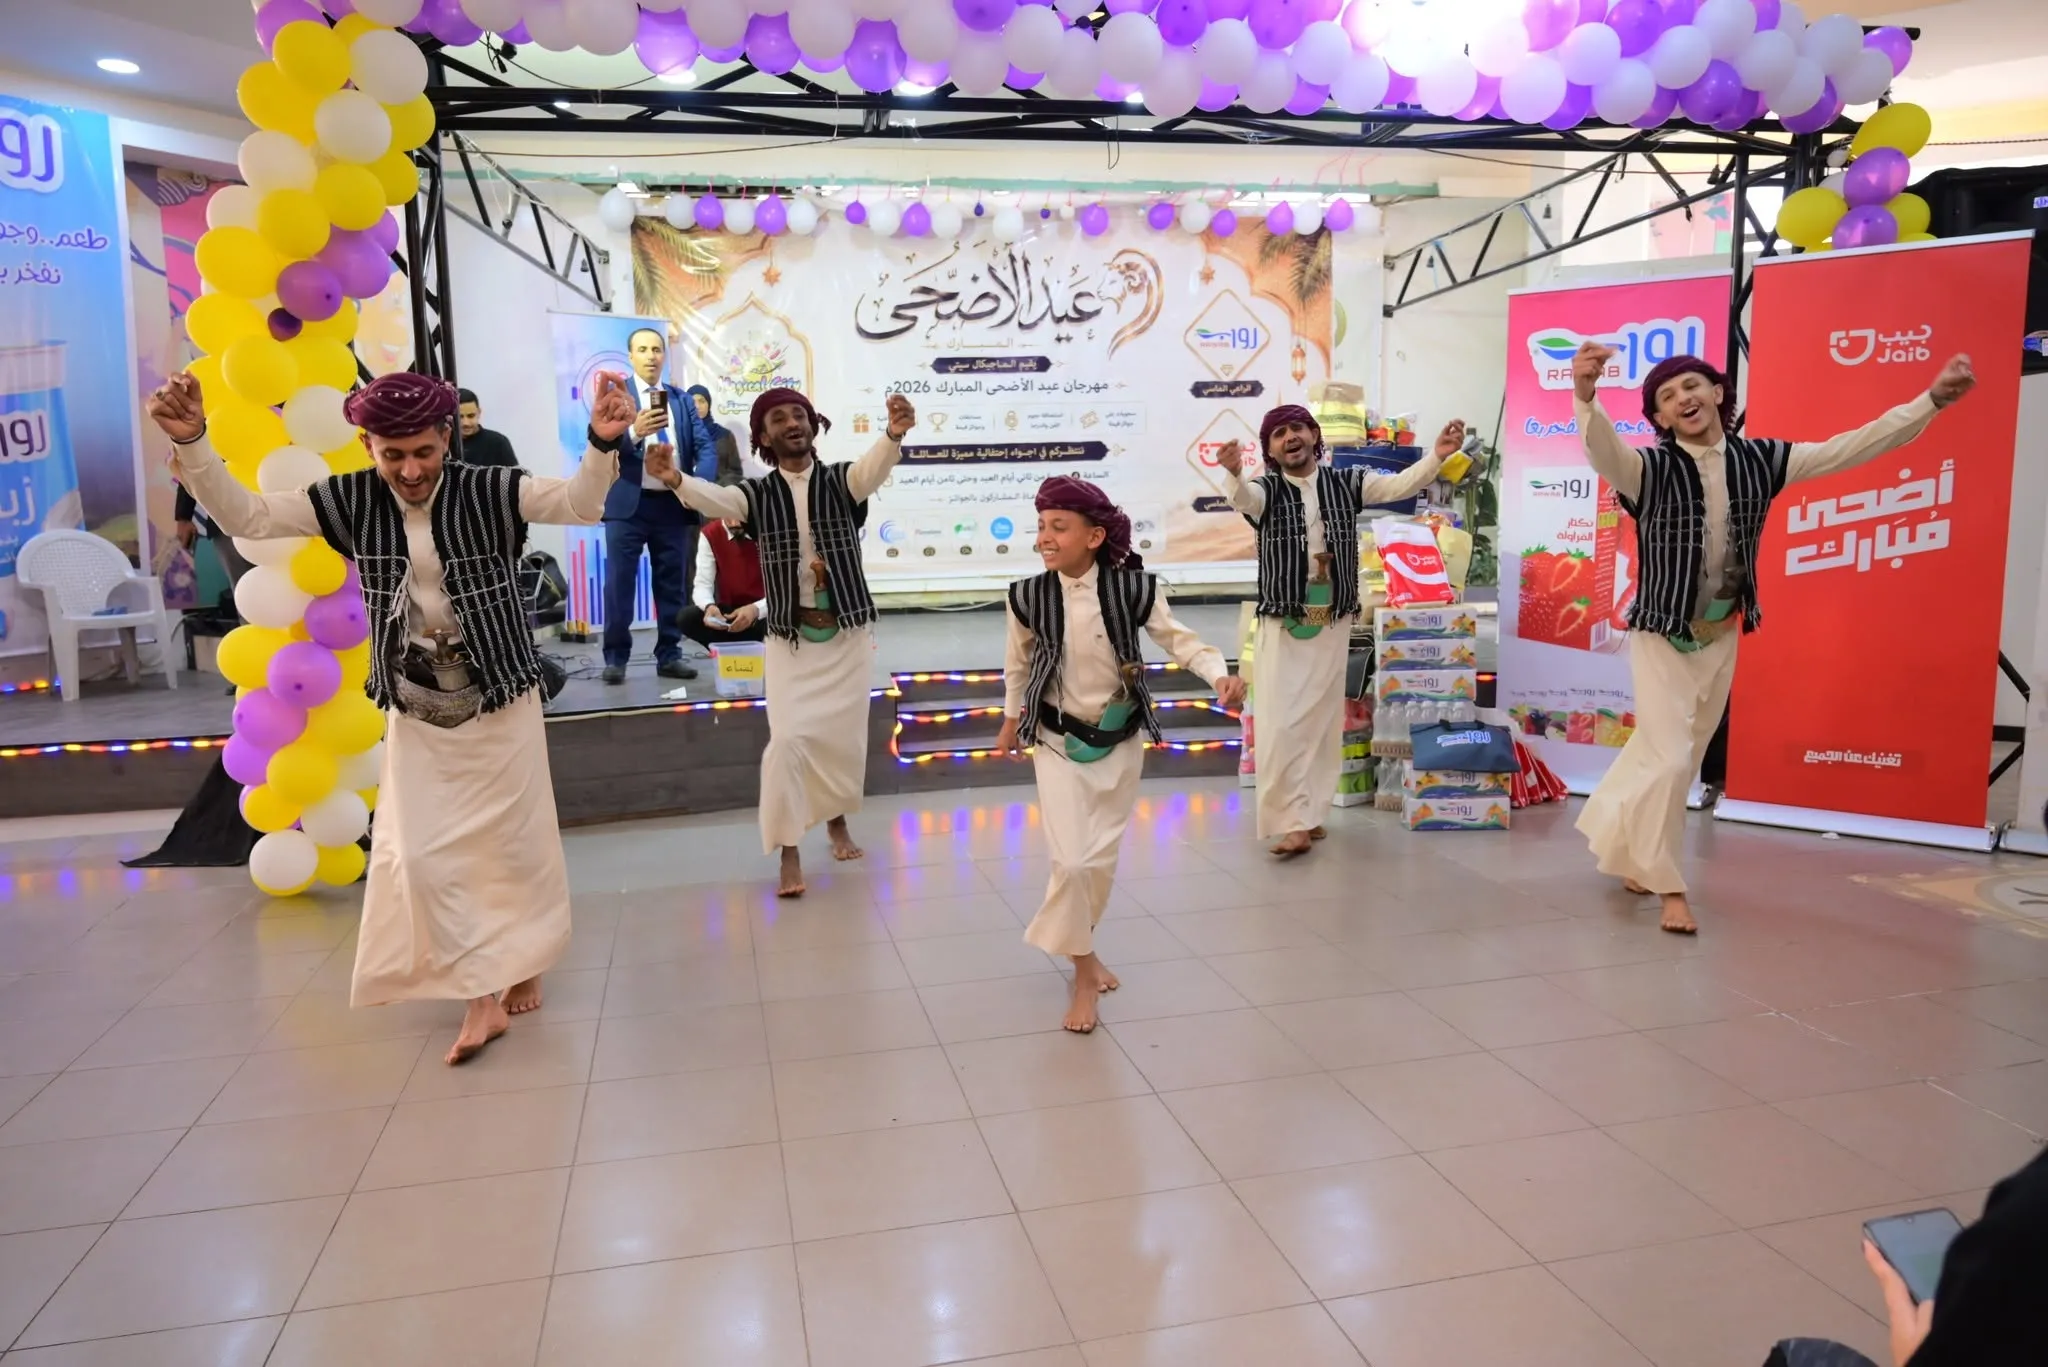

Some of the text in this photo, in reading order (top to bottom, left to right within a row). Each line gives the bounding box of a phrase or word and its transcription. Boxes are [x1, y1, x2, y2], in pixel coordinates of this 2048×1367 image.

[0, 118, 54, 182] رو
[14, 262, 61, 285] نفخر
[1018, 268, 1103, 343] عيد
[1878, 324, 1932, 346] جيب
[1877, 347, 1930, 363] Jaib
[948, 359, 1037, 374] يقيم الماجيكال سيتي
[1547, 366, 1620, 380] RAAB
[936, 380, 983, 396] المبارك
[986, 377, 1034, 395] الأضحى
[1038, 382, 1060, 395] عيد
[1063, 379, 1109, 395] مهرجان
[0, 414, 47, 457] روا
[1545, 418, 1577, 437] فخر
[909, 449, 949, 459] للعائلة
[951, 448, 974, 460] مميزة
[1039, 446, 1047, 460] في
[1804, 749, 1902, 769] تغنيك عن الجميع
